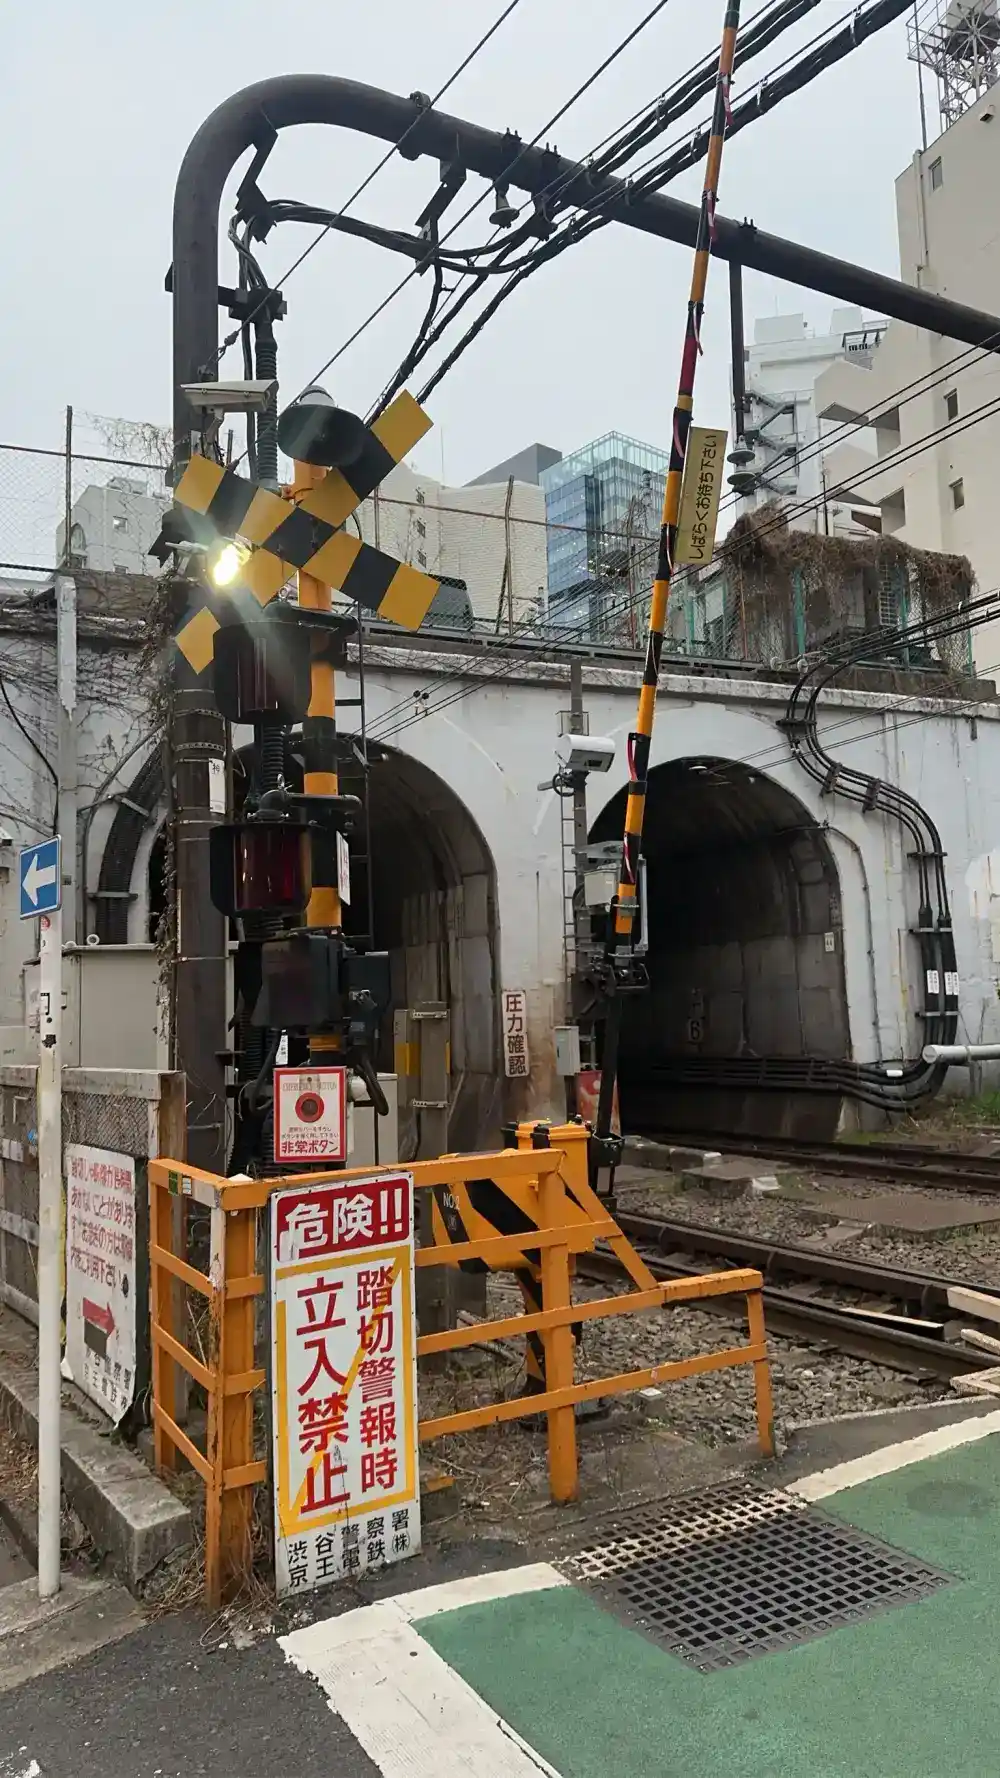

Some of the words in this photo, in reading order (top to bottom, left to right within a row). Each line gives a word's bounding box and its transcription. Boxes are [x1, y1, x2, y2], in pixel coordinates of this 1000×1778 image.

[688, 434, 717, 560] しばらくお待ち下さい
[505, 993, 527, 1075] 圧力確認
[281, 1139, 339, 1154] 非常ボタン
[296, 1276, 351, 1514] 立入禁止
[356, 1265, 399, 1493] 踏切警報時
[288, 1508, 410, 1565] 渋谷警察署
